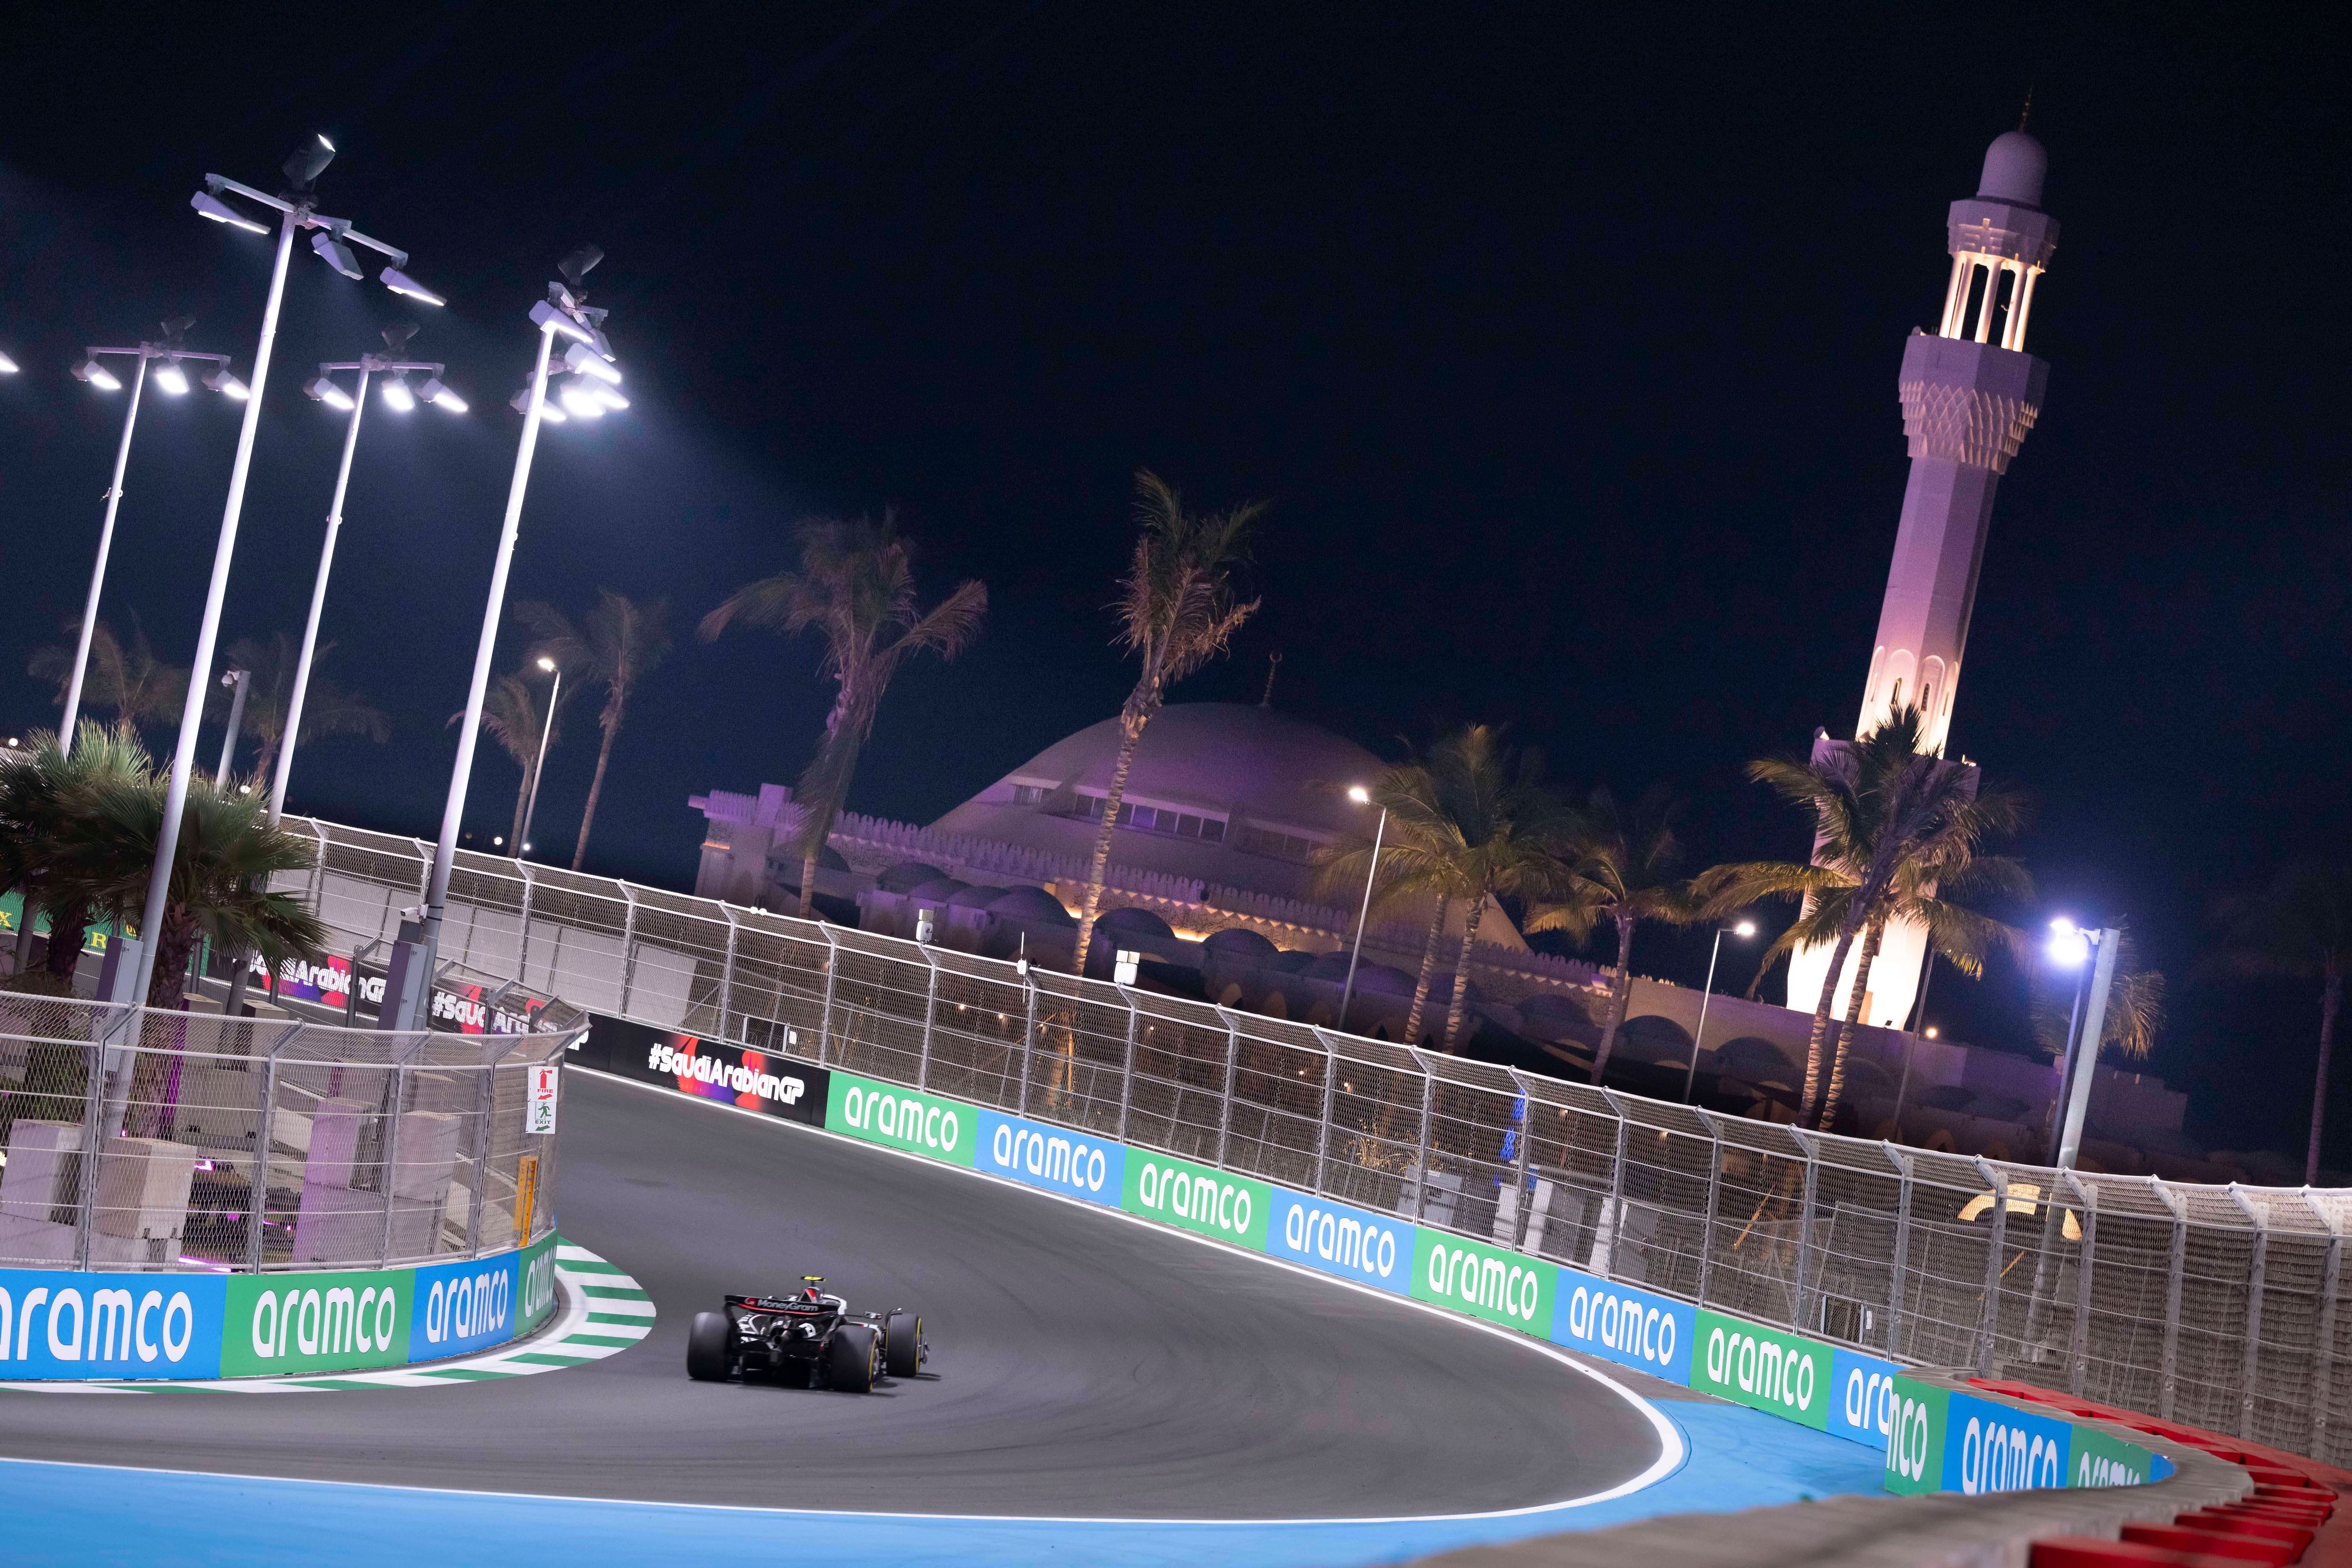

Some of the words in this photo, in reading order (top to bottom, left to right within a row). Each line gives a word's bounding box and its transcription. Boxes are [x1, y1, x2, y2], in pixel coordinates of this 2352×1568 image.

[648, 1042, 805, 1105] #SaudiArabianGP
[844, 1086, 958, 1152] aramco
[993, 1124, 1105, 1192] aramco
[1139, 1162, 1251, 1235] aramco
[1286, 1203, 1395, 1278] aramco
[426, 1268, 509, 1343] aramco
[757, 1299, 819, 1312] MoneyGram
[1428, 1243, 1538, 1321] aramco
[252, 1286, 396, 1358] aramco
[1569, 1285, 1676, 1366] aramco
[1707, 1326, 1815, 1411] aramco
[1846, 1367, 1893, 1436] ara
